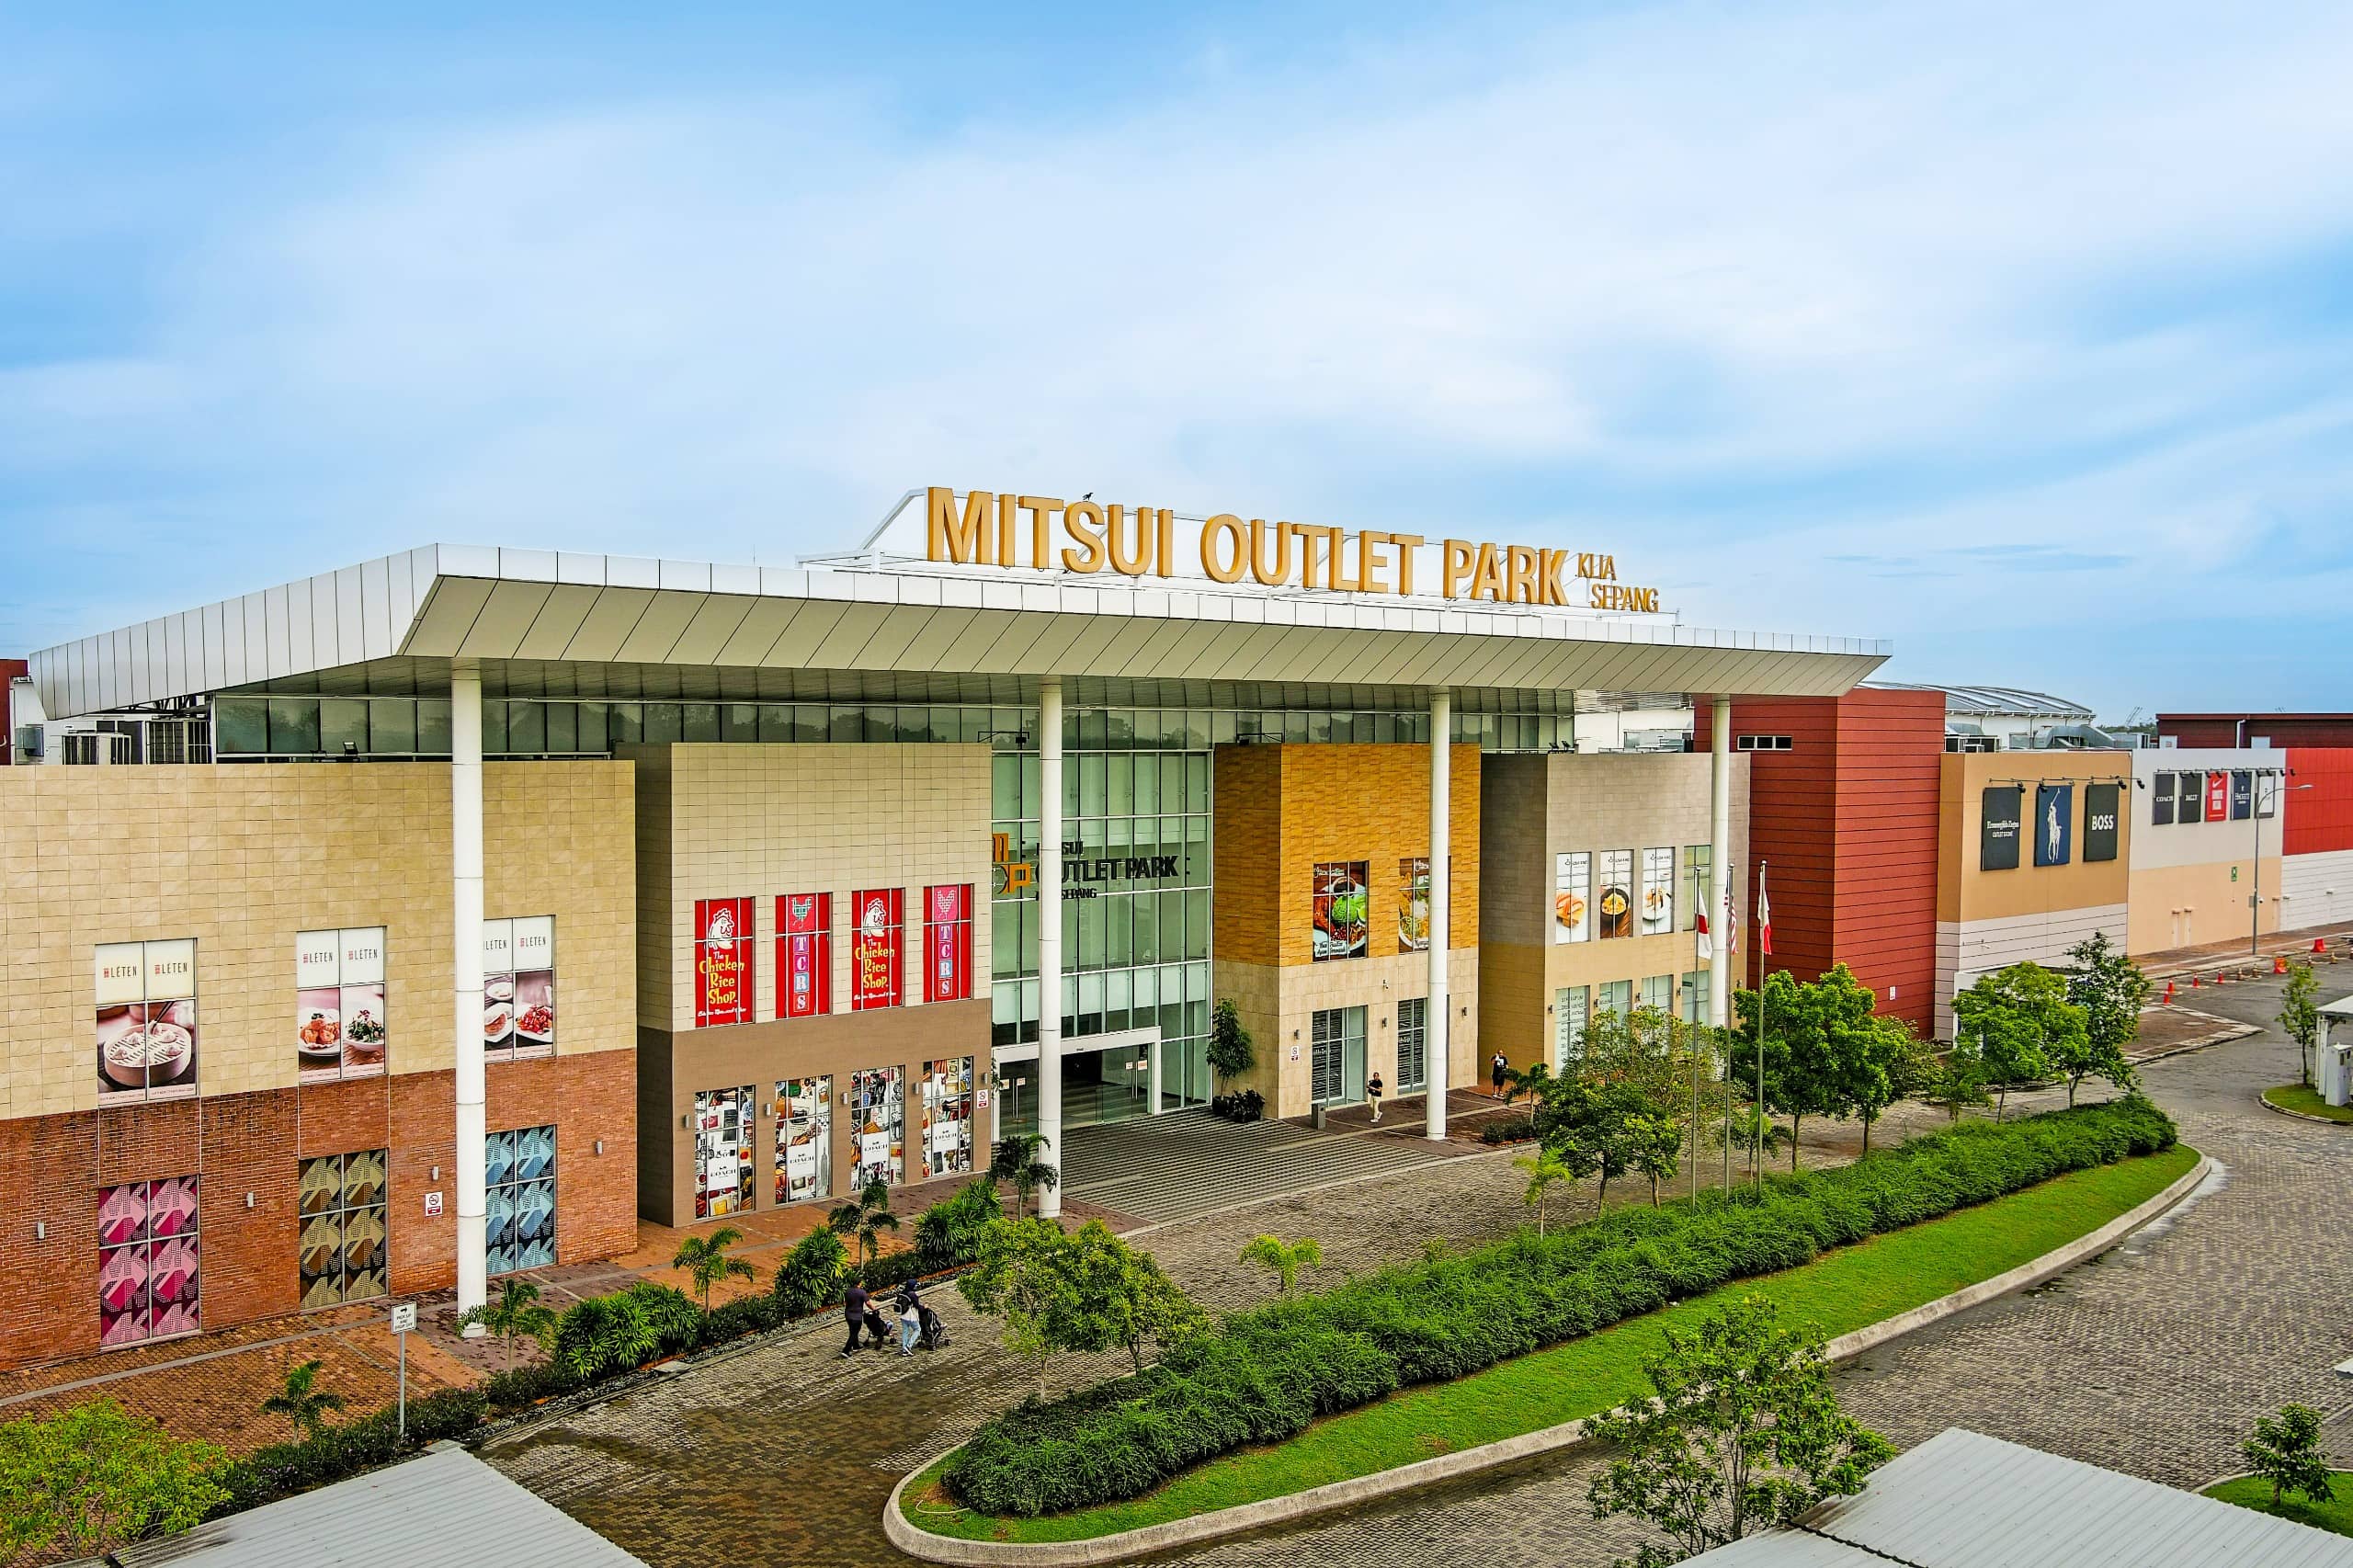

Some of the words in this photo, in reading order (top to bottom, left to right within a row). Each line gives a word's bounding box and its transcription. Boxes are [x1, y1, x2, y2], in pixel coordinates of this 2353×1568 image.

[927, 487, 1173, 577] MITSUI
[1200, 514, 1424, 596] OUTLET
[1443, 539, 1569, 607] PARK
[1578, 553, 1616, 581] KLIA
[1591, 584, 1658, 613] SEPANG
[2091, 814, 2114, 831] BOSS
[1125, 855, 1178, 880] PARK
[855, 941, 895, 960] Chicken
[699, 954, 745, 974] Chicken
[863, 959, 887, 975] Rice
[710, 972, 735, 989] Rice
